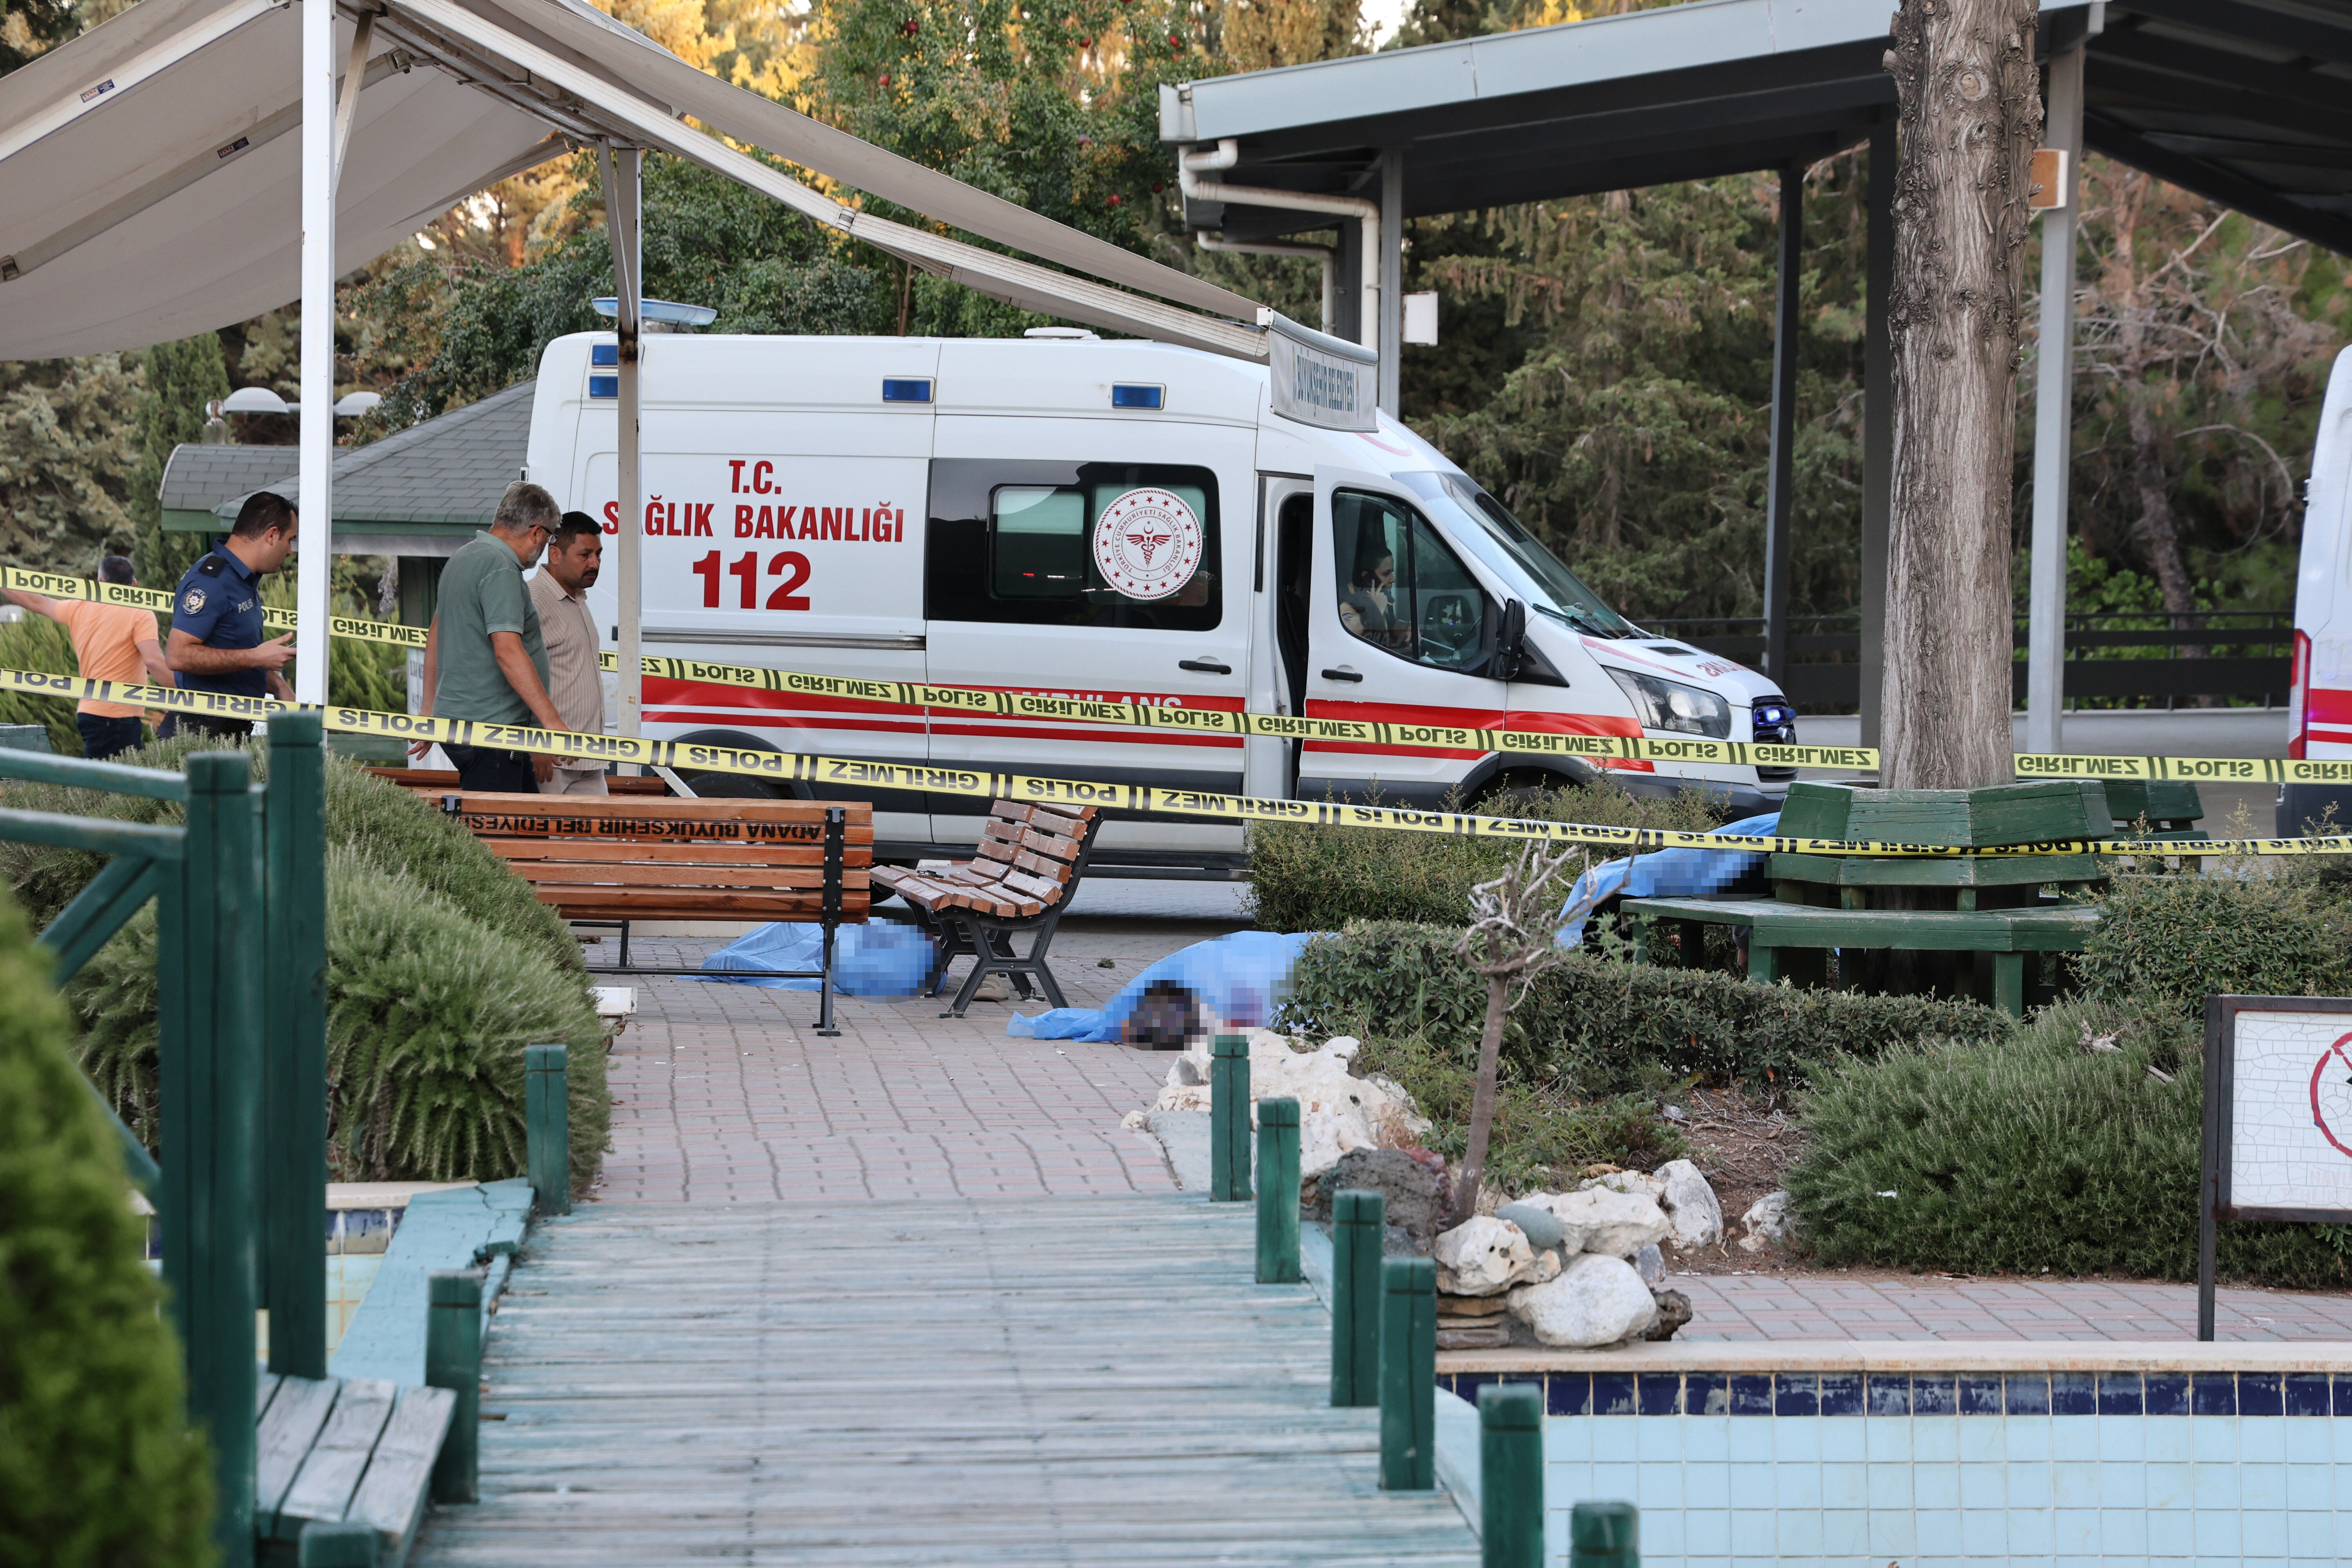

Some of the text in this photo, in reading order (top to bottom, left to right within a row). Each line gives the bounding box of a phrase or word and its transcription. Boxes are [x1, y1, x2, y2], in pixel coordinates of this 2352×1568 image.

[729, 460, 782, 494] T.C.
[603, 495, 904, 542] SĞLIK BAKANLIĞI
[1115, 509, 1181, 573] TÜRKİYE CUMHURİYETİ SAĞLIK BAKANLIĞI
[693, 550, 811, 610] 112
[238, 598, 254, 613] POLİS
[339, 709, 435, 735] POLİS
[485, 725, 640, 757] GİRİLMEZ
[690, 747, 782, 771] POLİS
[829, 761, 979, 790] GİRİLMEZ
[1027, 779, 1116, 802] POLİS
[1163, 790, 1308, 817] GİRİLMEZ
[1355, 808, 1443, 826] POLİS
[748, 824, 822, 839] ADANA
